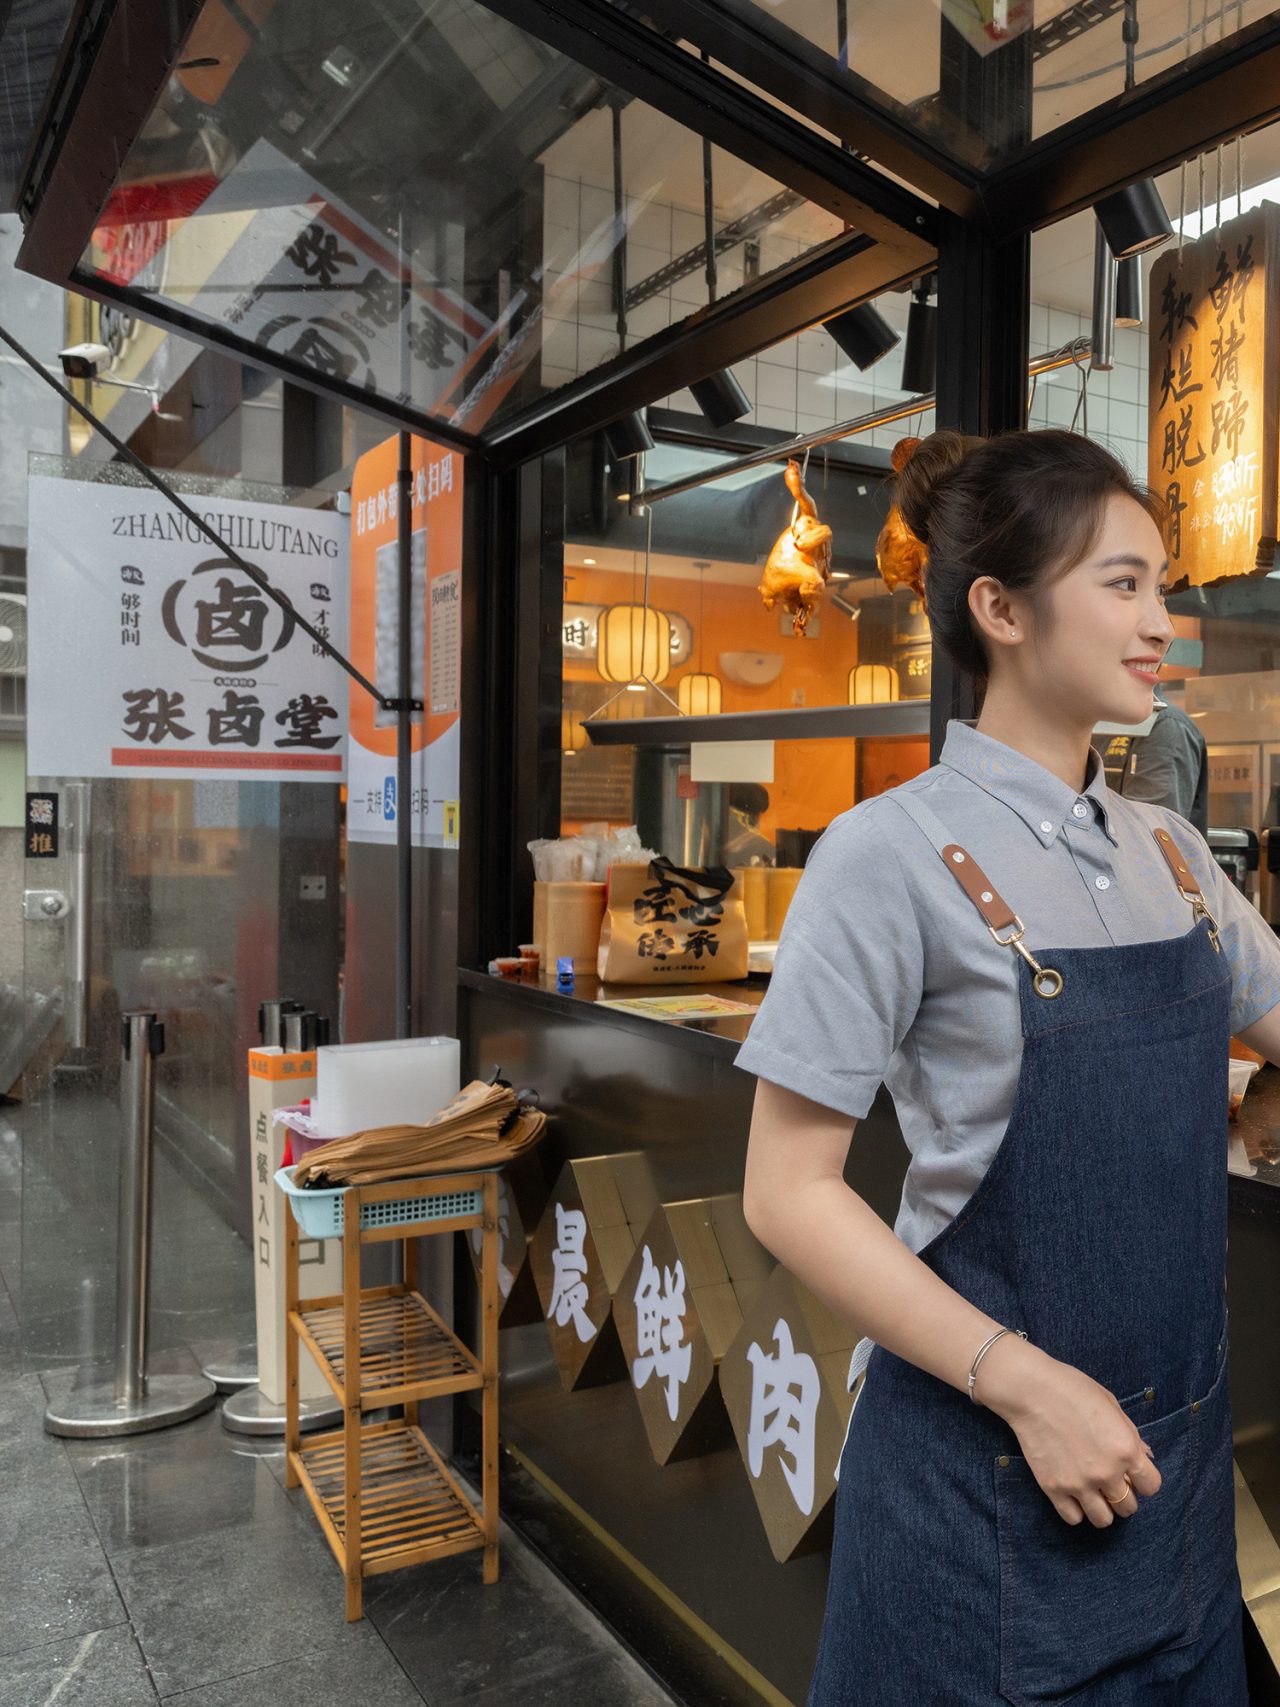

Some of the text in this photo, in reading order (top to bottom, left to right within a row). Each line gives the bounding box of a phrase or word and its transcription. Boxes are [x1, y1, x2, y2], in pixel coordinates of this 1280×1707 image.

[112, 512, 339, 558] ZHANGSHILUTANG
[121, 593, 141, 646] 够时间
[194, 577, 269, 651] 卤
[121, 688, 342, 749] 张卤堂
[256, 1111, 270, 1268] 点餐入口
[746, 1318, 821, 1516] 肉
